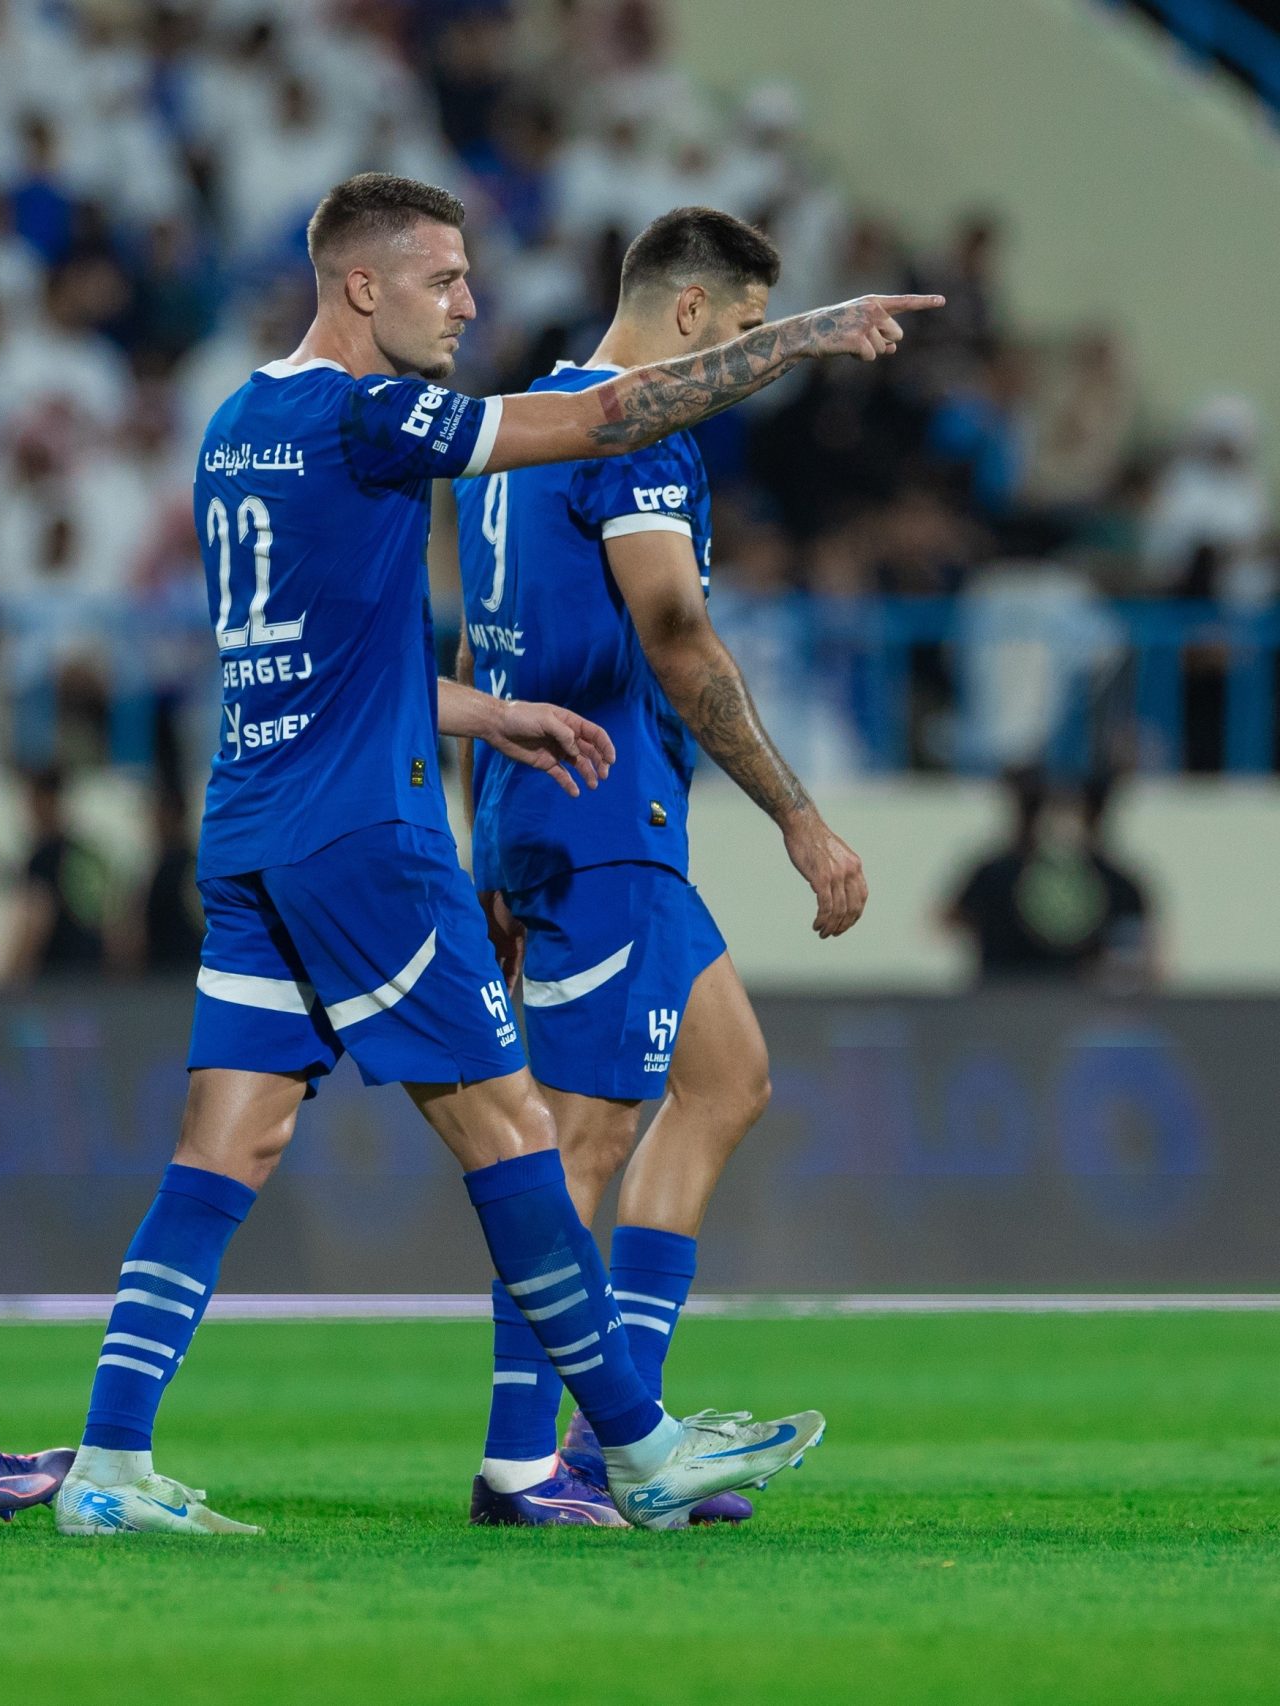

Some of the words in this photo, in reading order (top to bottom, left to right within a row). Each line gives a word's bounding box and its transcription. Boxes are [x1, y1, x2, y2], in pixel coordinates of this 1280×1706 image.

[400, 384, 450, 438] tree
[204, 443, 251, 477] الرياض
[252, 443, 305, 477] بنك
[480, 471, 509, 613] 9
[206, 495, 307, 651] 22
[223, 652, 313, 691] SERGEJ
